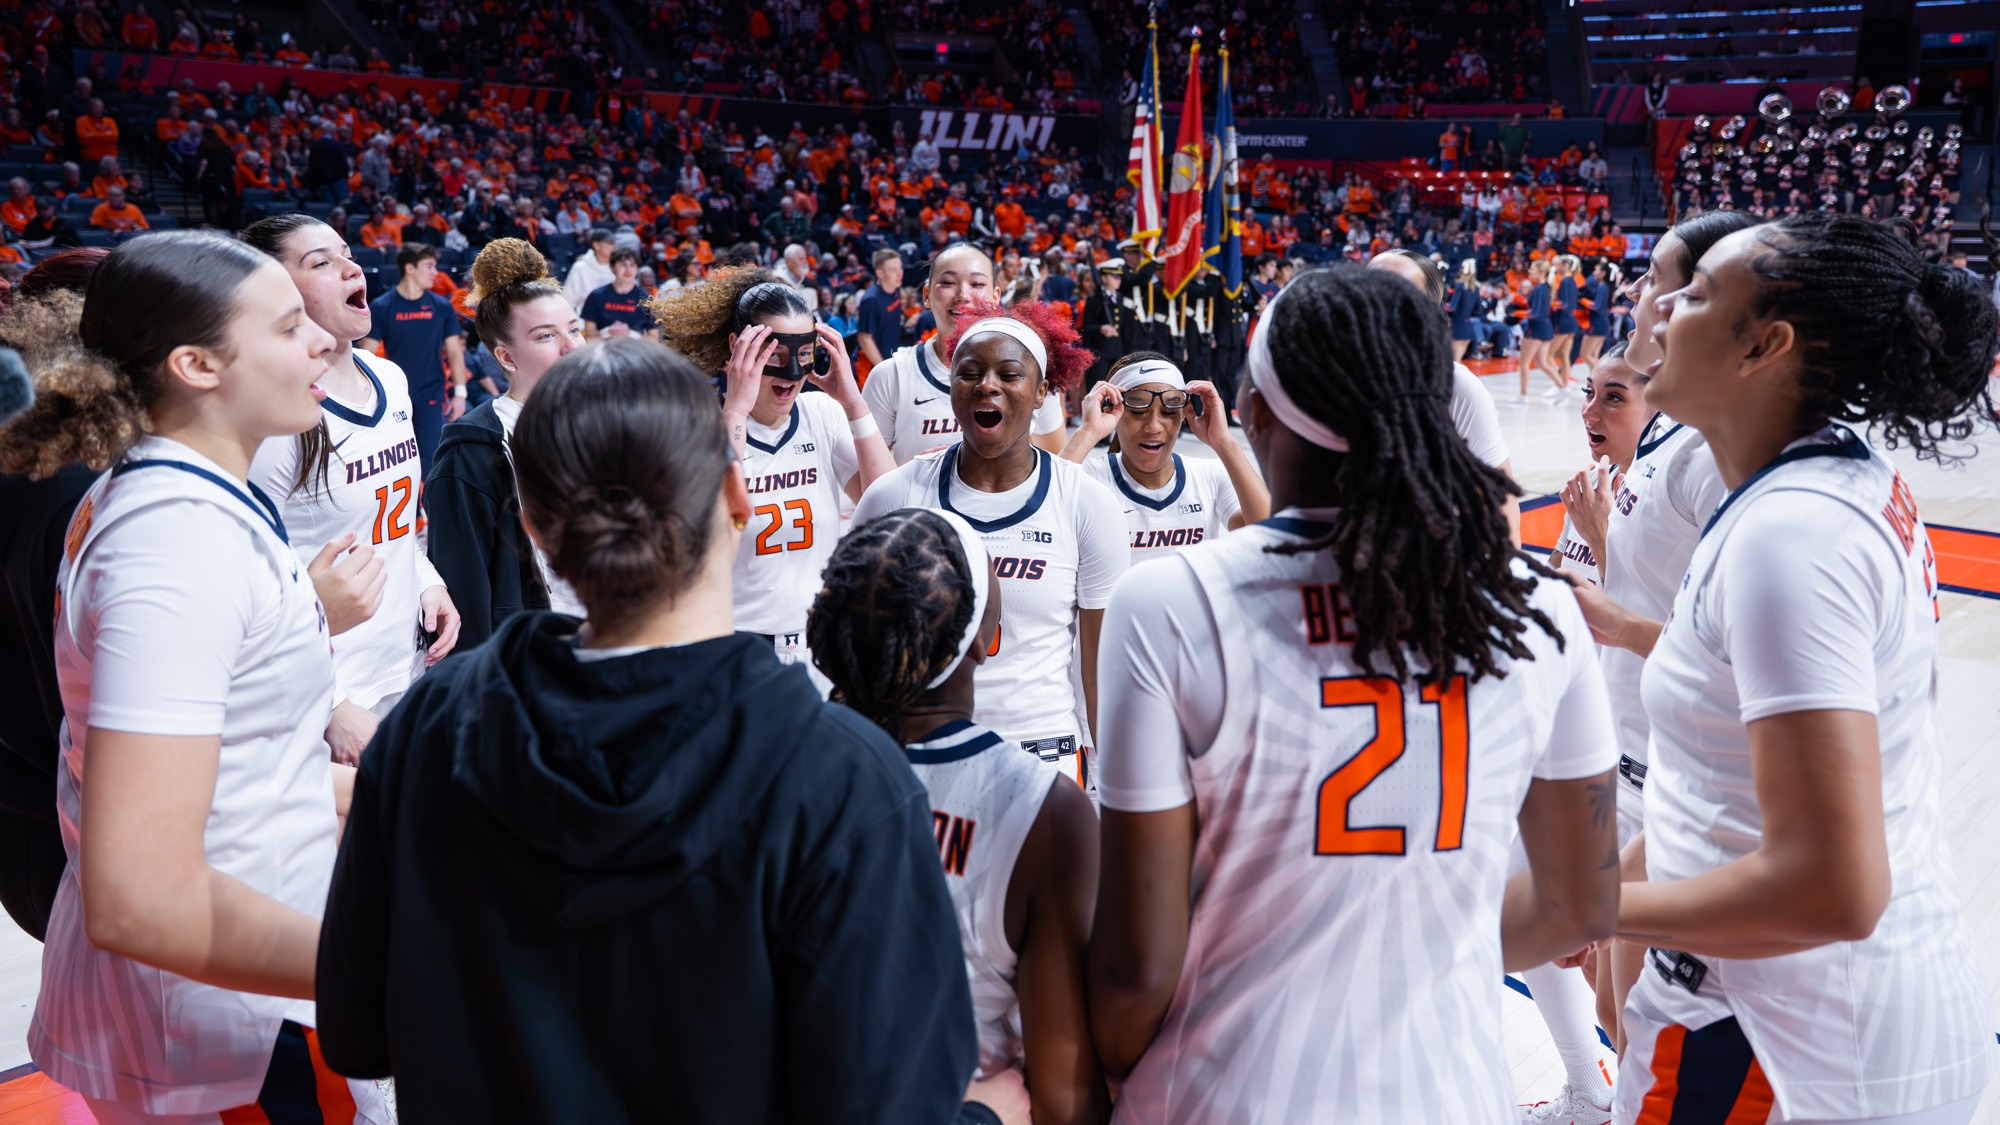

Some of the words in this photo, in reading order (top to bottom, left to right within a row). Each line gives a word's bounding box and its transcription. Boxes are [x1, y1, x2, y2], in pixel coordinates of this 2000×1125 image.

[919, 110, 1056, 151] ILLINI
[1235, 131, 1263, 147] arm
[1264, 134, 1307, 147] CENTER
[921, 418, 963, 435] ILLI
[345, 437, 418, 485] ILLINOIS
[745, 467, 818, 494] LLINOIS
[371, 475, 412, 546] 12
[754, 498, 814, 557] 23
[1301, 583, 1357, 646] BE
[1060, 741, 1070, 750] 42
[1313, 672, 1470, 857] 21
